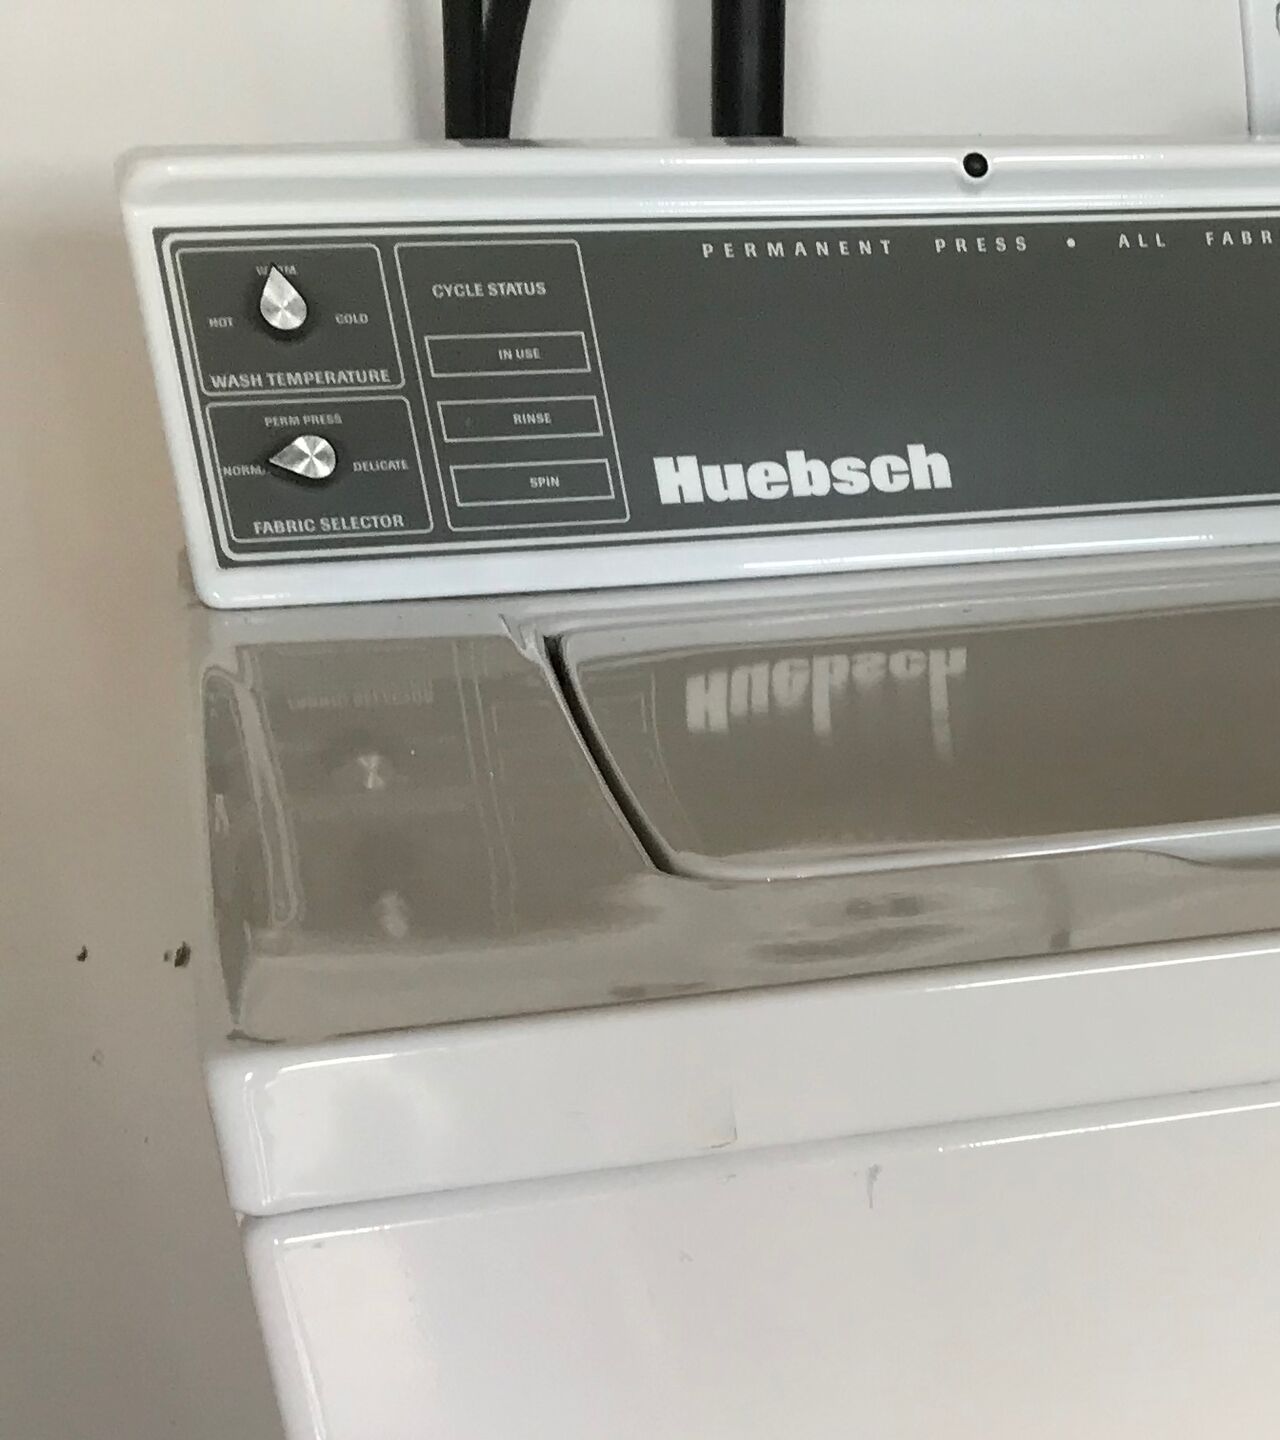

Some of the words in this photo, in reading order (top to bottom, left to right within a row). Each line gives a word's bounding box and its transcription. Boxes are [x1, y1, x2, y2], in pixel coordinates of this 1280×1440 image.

[702, 239, 890, 258] PERMANENT
[934, 236, 1026, 254] PRESS
[1118, 232, 1166, 249] ALL
[432, 283, 485, 298] CYCLE
[487, 281, 547, 296] STATUS
[209, 316, 234, 328] HOT
[335, 313, 369, 325] COLD
[499, 349, 513, 360] IN
[516, 348, 540, 359] USE
[210, 373, 263, 389] WASH
[266, 369, 391, 387] TEMPERATURE
[264, 415, 300, 427] PERM
[303, 413, 343, 425] PRESS
[513, 412, 552, 425] RINSE
[352, 459, 409, 473] DELICATE
[653, 443, 953, 505] Huebsch
[529, 476, 560, 489] SPIN
[253, 518, 316, 535] FABRIC
[320, 514, 405, 532] SELECTOR
